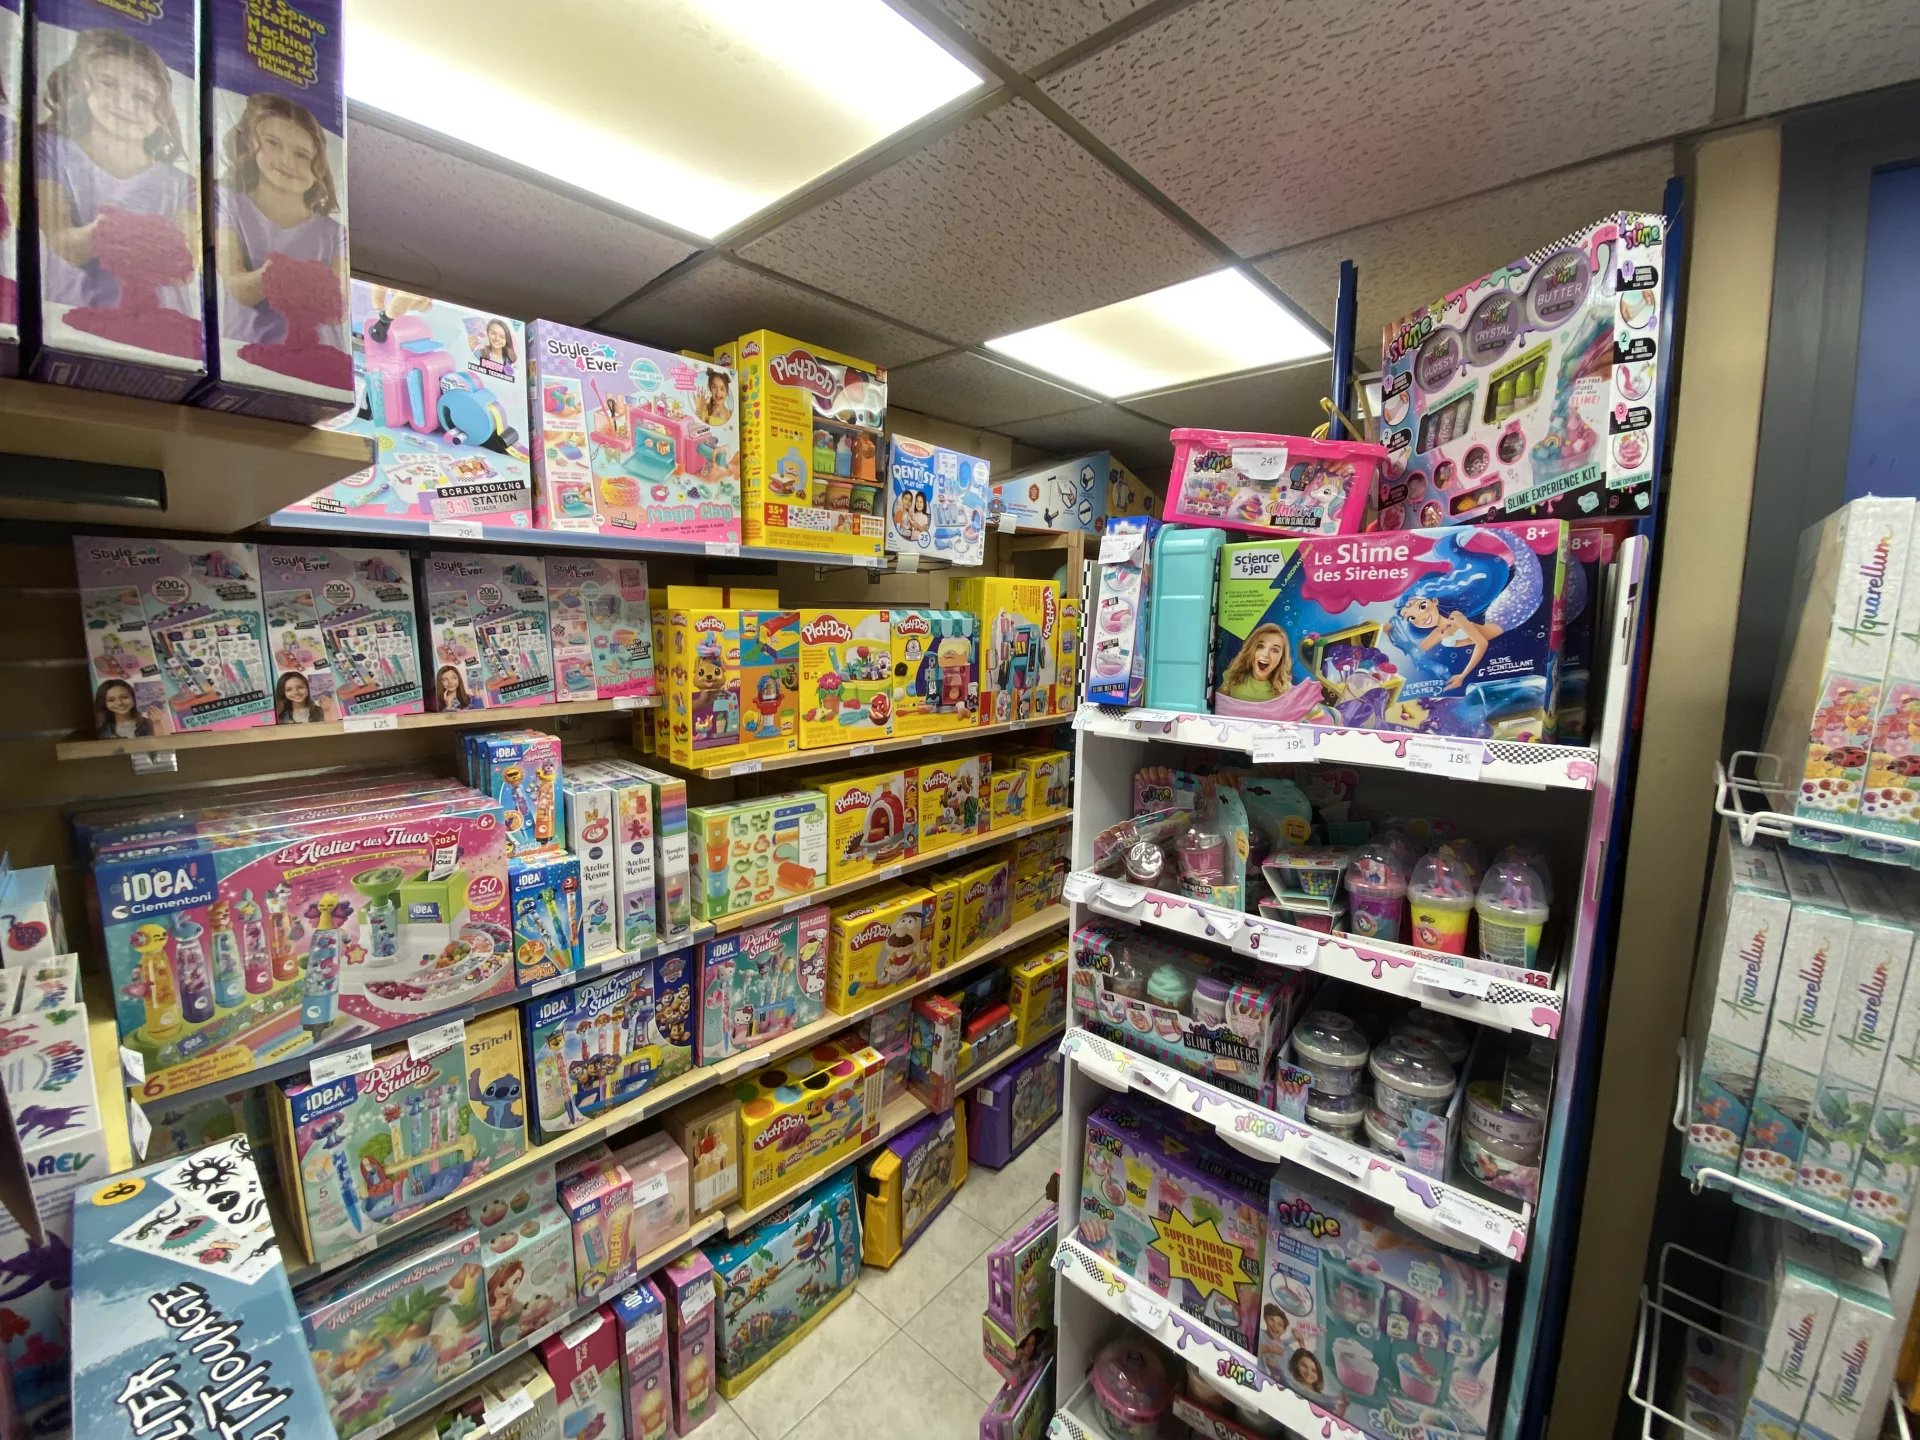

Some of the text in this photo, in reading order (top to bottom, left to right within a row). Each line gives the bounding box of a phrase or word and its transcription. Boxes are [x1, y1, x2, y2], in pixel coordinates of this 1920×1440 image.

[249, 2, 312, 39] Station
[247, 16, 313, 55] Machine
[261, 38, 313, 66] glaces
[1537, 282, 1583, 306] BUTTER
[1475, 325, 1514, 341] CRYSTAL
[548, 341, 590, 357] Style
[575, 356, 619, 373] 4Ever
[770, 355, 833, 393] Play-Doh
[1424, 356, 1455, 377] GLOSSY
[892, 464, 936, 486] DENTIST
[441, 481, 522, 497] SCRAPBOOKING
[1507, 466, 1599, 511] SLIME EXPERIENCE KIT
[472, 493, 519, 507] STATION
[768, 505, 784, 514] 35+
[648, 504, 734, 524] Magic Clay
[1266, 501, 1325, 519] Unicorn
[1291, 518, 1318, 527] SLIME CASE
[1526, 527, 1549, 541] 8+
[1571, 537, 1592, 550] 8+
[91, 548, 132, 561] Style
[118, 554, 162, 568] 4Ever
[272, 555, 307, 567] Style
[1234, 553, 1280, 566] science
[1314, 541, 1410, 566] Le Slime
[296, 561, 332, 572] 4Ever
[434, 561, 463, 573] Style
[453, 566, 484, 577] 4Ever
[553, 564, 578, 574] Style
[1242, 564, 1269, 576] & jeu
[1313, 566, 1410, 582] des Sirènes
[155, 580, 185, 591] 200+
[325, 583, 350, 593] 200+
[479, 587, 499, 596] 200+
[1838, 523, 1895, 647] Aquarellum
[1042, 588, 1057, 639] Play-Doh
[695, 620, 725, 633] Play-Doh
[803, 624, 851, 644] Play-Doh
[899, 619, 929, 634] Play-Doh
[1486, 659, 1534, 674] SCINTILLANT
[1489, 656, 1512, 667] SLIME
[355, 683, 415, 702] SCRAPBOOKING
[500, 676, 549, 693] SCRAPBOOKING
[1406, 680, 1445, 690] PENDENTIFS
[1420, 686, 1435, 696] MER
[191, 691, 266, 713] SCRAPBOOKING
[186, 716, 198, 726] KIT
[237, 702, 261, 713] ACTIVITY
[924, 773, 952, 790] Play-Doh
[834, 790, 871, 814] Play-Doh
[480, 816, 493, 827] 6+
[278, 837, 361, 866] L'Atelier
[363, 836, 382, 848] des
[386, 827, 429, 846] Fluos
[435, 835, 457, 846] 2024
[584, 862, 610, 873] Atelier
[626, 857, 651, 868] Atelier
[626, 864, 652, 876] Résine
[583, 869, 611, 881] Résine
[479, 878, 498, 894] 50
[131, 892, 212, 914] Clementoni
[745, 922, 795, 951] Pen Creator
[852, 923, 891, 948] Play-Doh
[750, 938, 780, 960] Studio
[1720, 918, 1769, 1022] Aquarellum
[580, 968, 646, 1008] Pen Creator
[1527, 972, 1549, 988] 12
[1777, 937, 1832, 1042] Aquarellum
[588, 988, 628, 1017] Studio
[1836, 951, 1893, 1057] Aquarellum
[542, 1009, 575, 1026] Clementoni
[469, 1030, 513, 1057] STITCH
[1186, 1034, 1214, 1053] SLIME
[1215, 1040, 1259, 1065] SHAKERS
[863, 1052, 875, 1061] 36
[143, 1076, 166, 1097] 6
[365, 1061, 402, 1093] Pen
[376, 1064, 431, 1103] Studio
[310, 1098, 355, 1119] Clementoni
[754, 1113, 804, 1149] Play-Doh
[1471, 1112, 1503, 1133] SLIME
[319, 1186, 328, 1198] 5
[608, 1223, 624, 1269] DREAM
[1163, 1226, 1233, 1259] SUPER PROMO
[1178, 1245, 1186, 1258] 3
[1188, 1249, 1234, 1275] SLIMES
[1181, 1260, 1224, 1288] BONUS
[348, 1282, 401, 1317] Fabrique
[411, 1257, 455, 1284] Bougies
[1765, 1305, 1818, 1391] Aquarellum
[148, 1281, 294, 1440] TATOUAGE
[1818, 1328, 1874, 1416] Aquarellum
[117, 1353, 195, 1440] LIER
